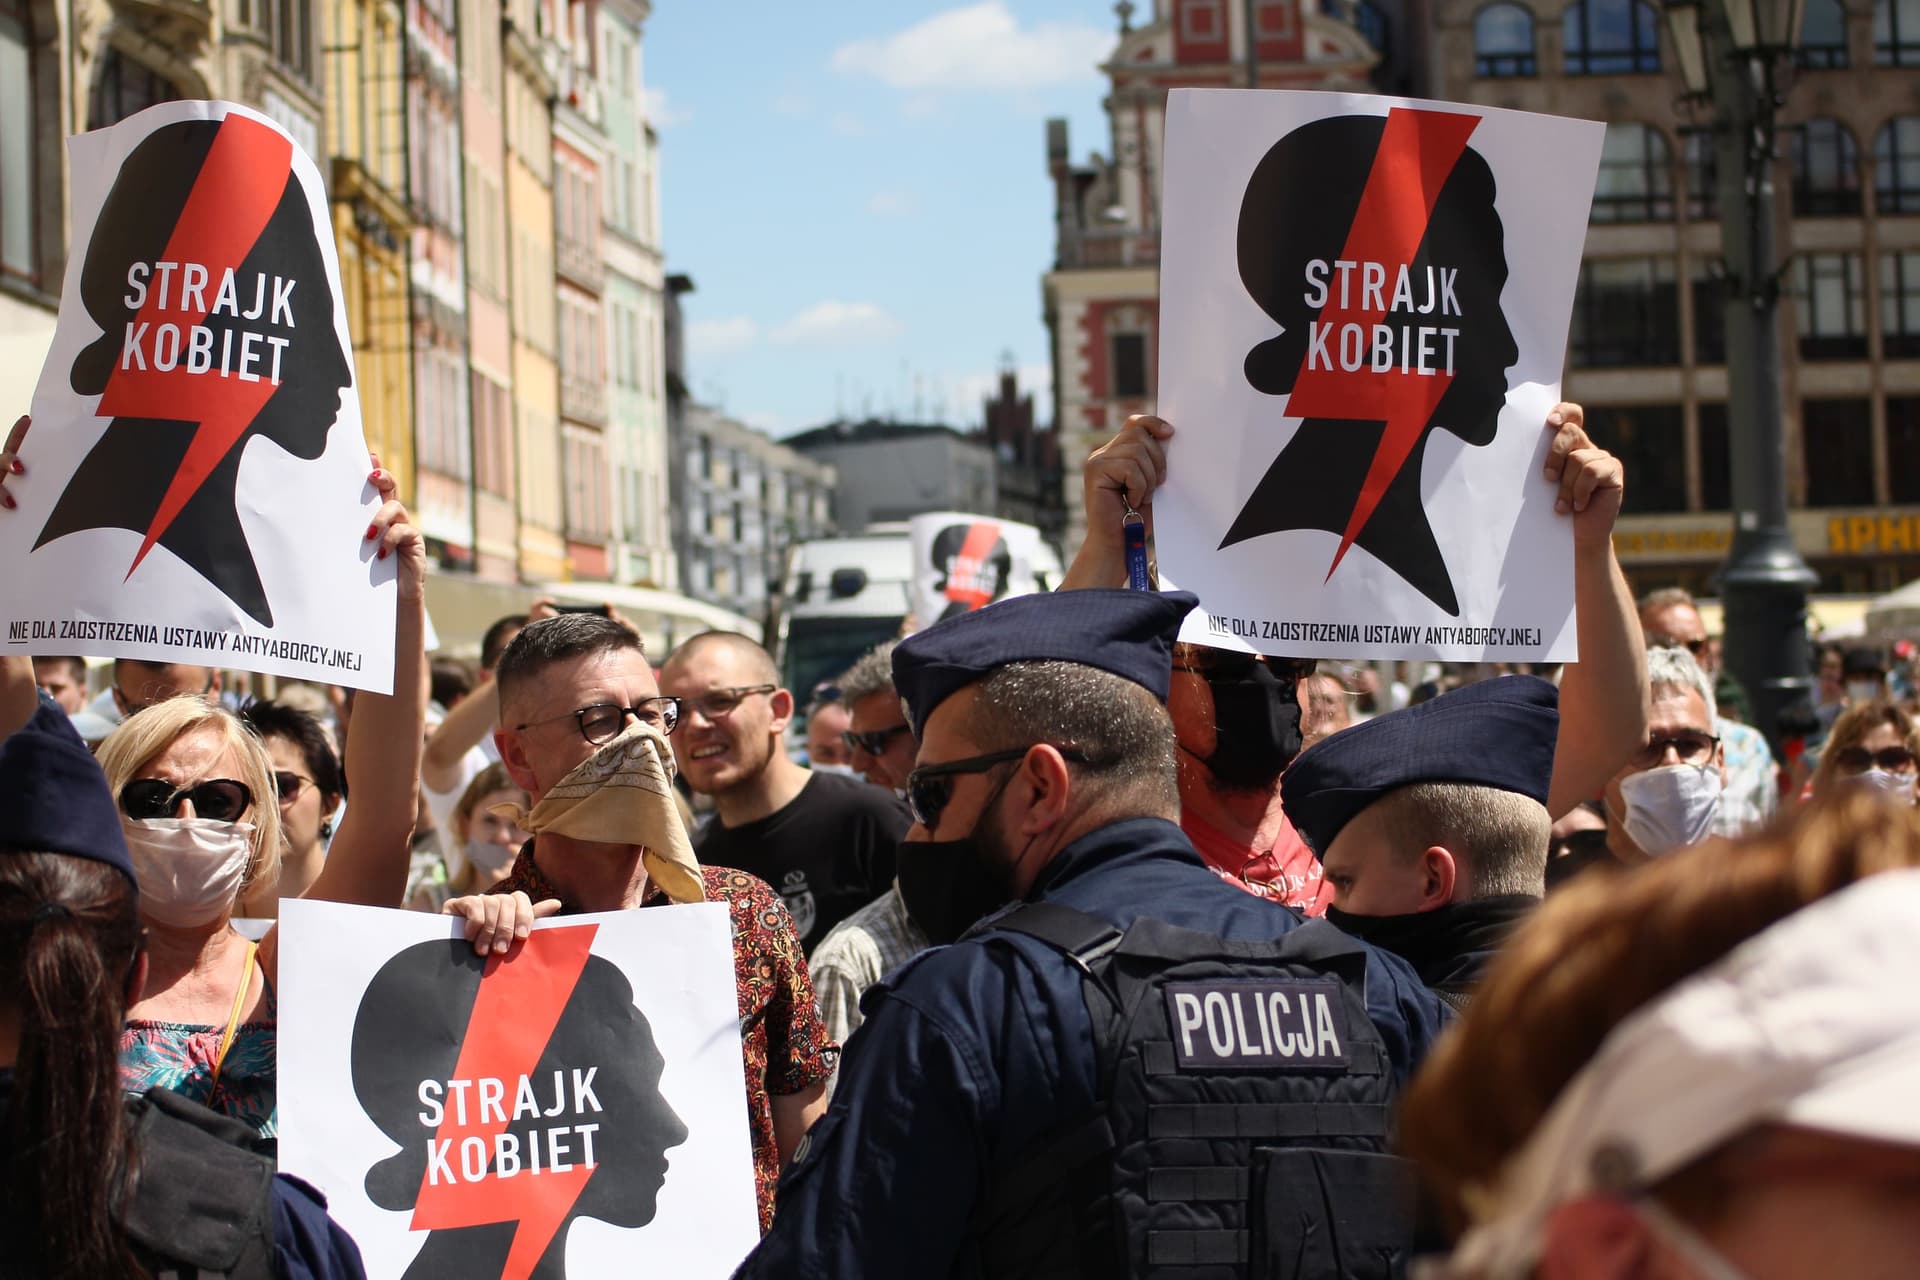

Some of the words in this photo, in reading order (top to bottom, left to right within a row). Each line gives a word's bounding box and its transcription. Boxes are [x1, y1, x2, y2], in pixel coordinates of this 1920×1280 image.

[124, 261, 297, 329] STRAJK
[1303, 258, 1463, 317] STRAJK
[121, 321, 290, 386] KOBIET
[1307, 320, 1460, 377] KOBIET
[8, 620, 29, 640] NIE
[32, 621, 56, 640] DLA
[60, 621, 158, 645] ZAOSTRZENIA
[163, 627, 228, 651] USTAWY
[231, 634, 363, 671] ANTYABORCYJNEJ
[1207, 614, 1229, 634] NIE
[1231, 617, 1258, 638] DLA
[1262, 620, 1360, 643] ZAOSTRZENIA
[1363, 625, 1421, 645] USTAWY
[1425, 626, 1542, 646] ANTYABORCYJNEJ
[1174, 991, 1341, 1057] POLICJA
[417, 1066, 603, 1127] STRAJK
[426, 1123, 600, 1186] KOBIET
